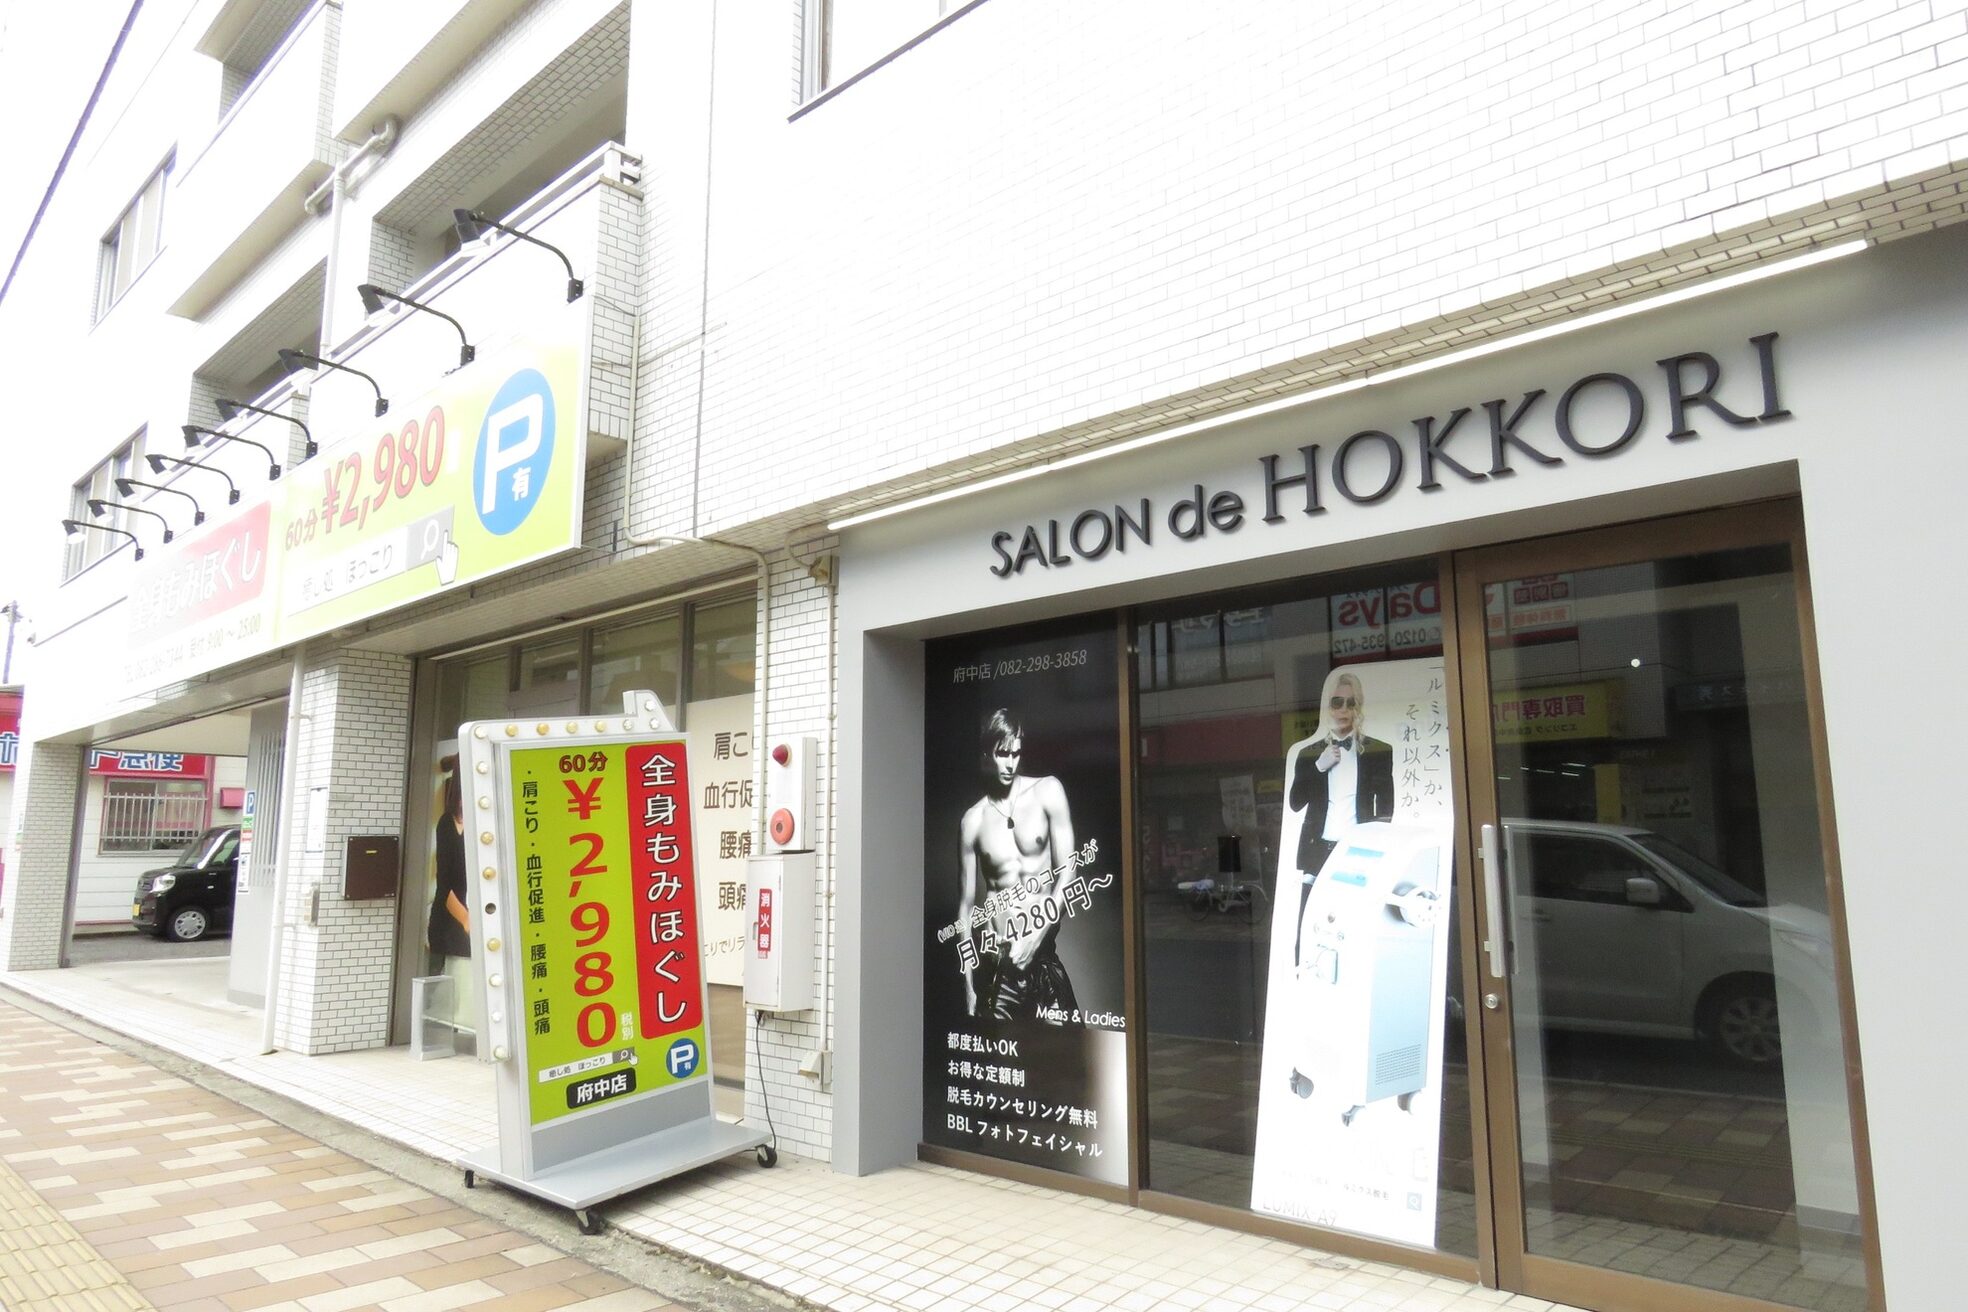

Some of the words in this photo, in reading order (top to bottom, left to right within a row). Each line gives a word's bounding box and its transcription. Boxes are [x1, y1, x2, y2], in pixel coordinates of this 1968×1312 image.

[990, 497, 1151, 578] SALON
[1167, 484, 1244, 541] de
[1259, 330, 1793, 523] HOKKORI
[285, 508, 318, 551] 60分
[321, 405, 445, 535] ¥2,980
[346, 543, 393, 585] ほっこり
[953, 663, 991, 684] 府中店
[558, 751, 608, 774] 60分
[714, 732, 754, 760] 肩こ
[640, 753, 687, 1023] 全身もみほぐし
[562, 777, 617, 1049] ¥2,980
[760, 892, 771, 948] 消火器
[1036, 1004, 1068, 1022] Mens
[1071, 1009, 1081, 1023] &
[1084, 1010, 1127, 1028] Ladies
[947, 1031, 1018, 1057] 都度払いOK
[578, 1056, 606, 1070] ほっこり
[947, 1060, 1025, 1087] お得な定額制
[577, 1074, 627, 1104] 府中店
[947, 1086, 1098, 1129] 脱毛カウンセリング無料
[947, 1114, 973, 1134] BBL
[977, 1119, 1103, 1158] フォトフェイシャル
